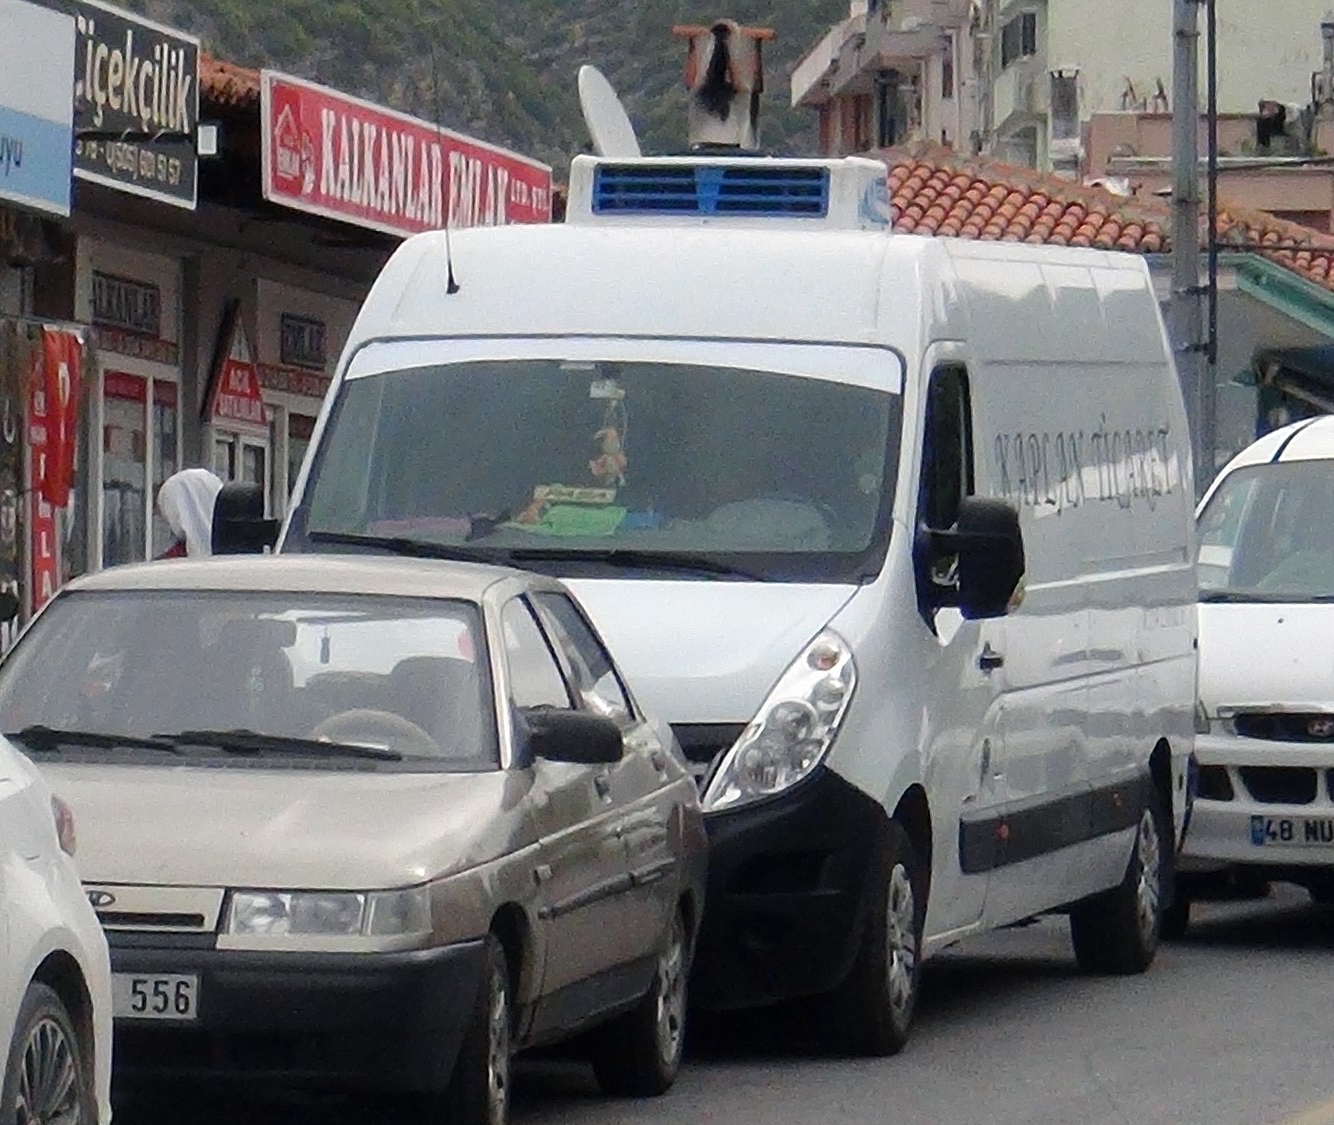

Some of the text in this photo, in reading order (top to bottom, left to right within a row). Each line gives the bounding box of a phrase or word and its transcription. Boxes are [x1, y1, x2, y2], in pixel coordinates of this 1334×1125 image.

[321, 107, 443, 229] KALKANLAR
[1266, 818, 1293, 842] 48
[1304, 818, 1334, 842] NU
[131, 978, 192, 1015] 556
